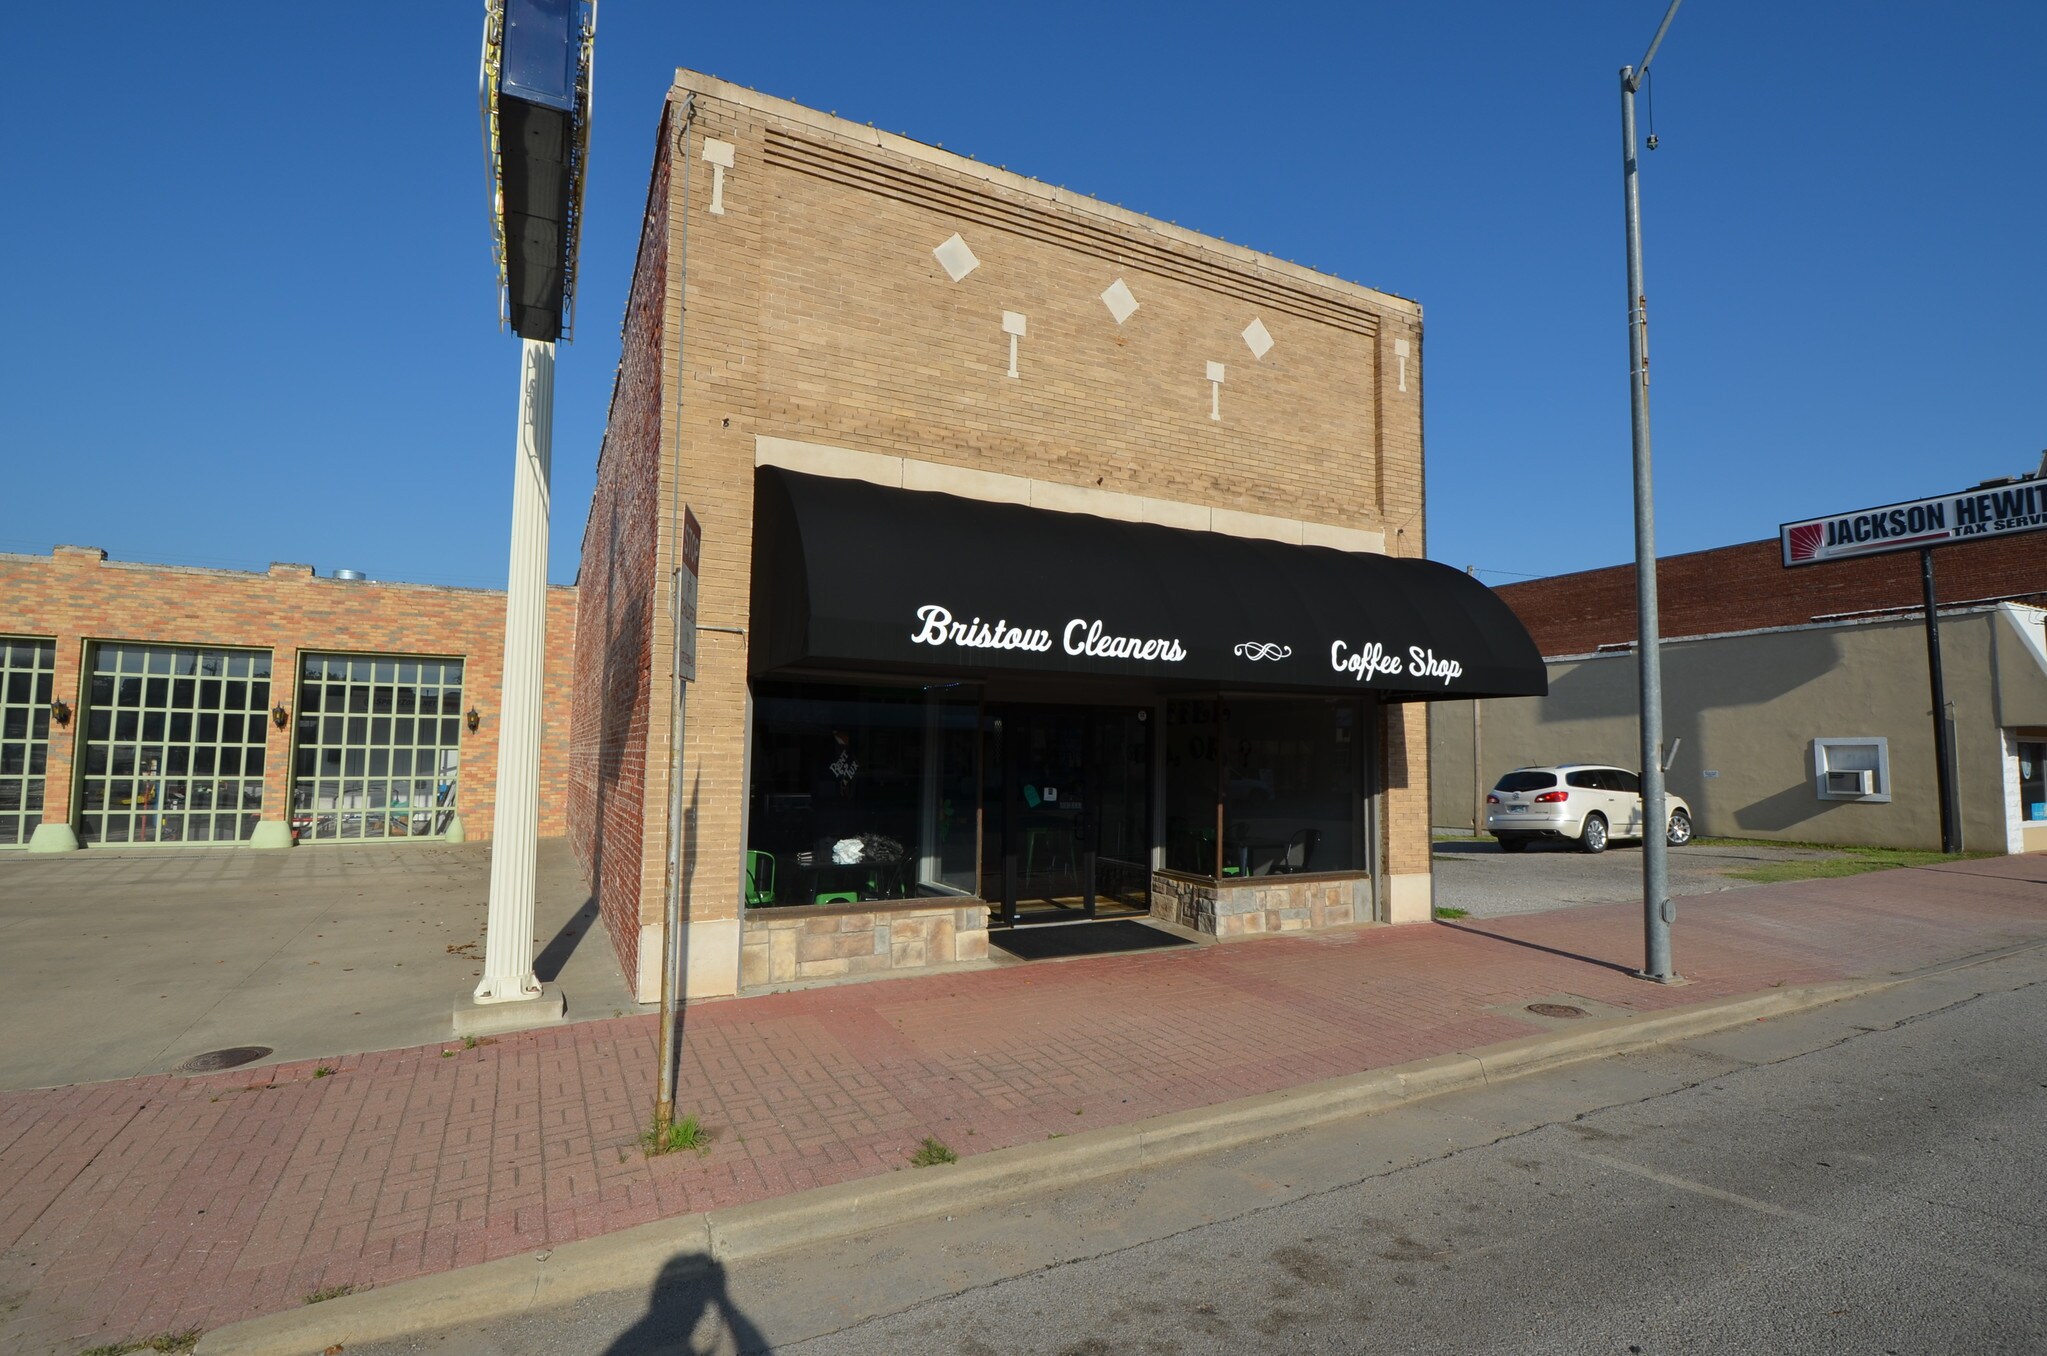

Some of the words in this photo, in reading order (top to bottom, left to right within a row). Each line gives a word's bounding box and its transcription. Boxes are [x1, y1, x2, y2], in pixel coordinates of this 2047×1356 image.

[684, 522, 700, 565] STOP
[1827, 502, 1945, 547] JACKSON
[1952, 522, 1988, 537] TAX
[910, 604, 1052, 652] Bristow
[1063, 618, 1188, 662] Cleaners
[1331, 640, 1402, 681] Coffee
[1408, 645, 1463, 686] Shop
[843, 761, 859, 780] TUX
